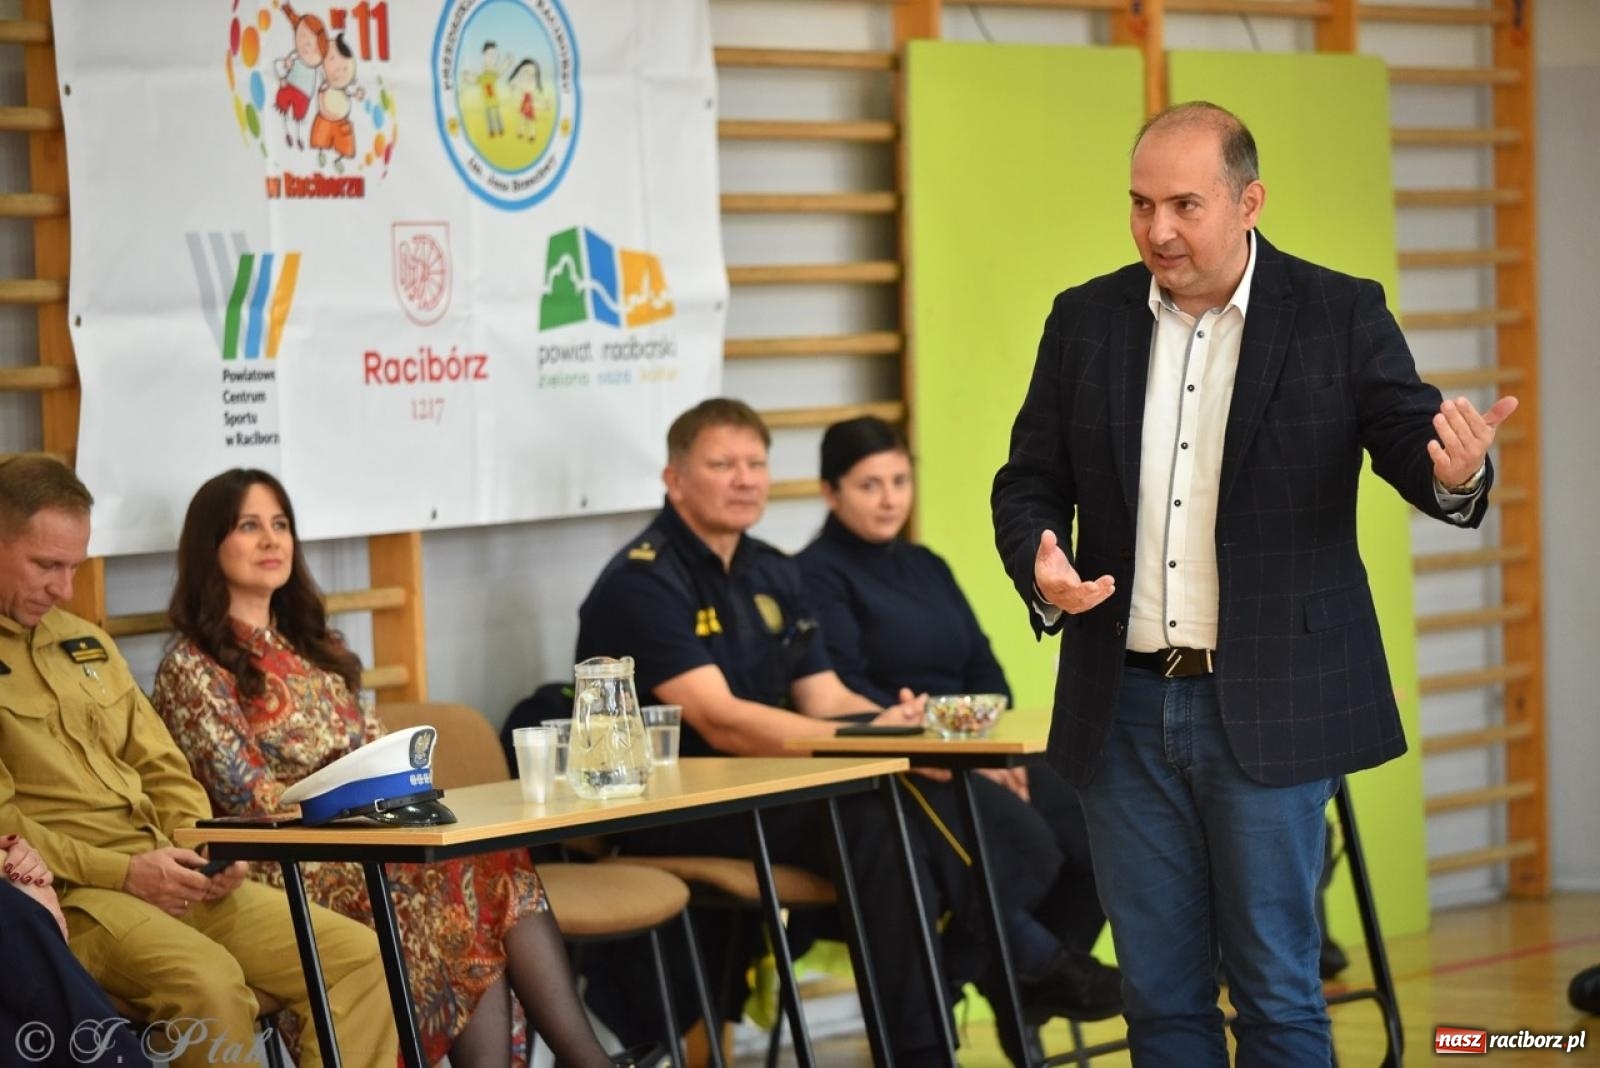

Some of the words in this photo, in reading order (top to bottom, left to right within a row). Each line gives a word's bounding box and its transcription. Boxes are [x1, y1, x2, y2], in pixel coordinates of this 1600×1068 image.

[351, 0, 390, 62] 11
[363, 345, 488, 386] Racibórz
[222, 390, 267, 405] Centrum
[224, 411, 259, 427] Sportu
